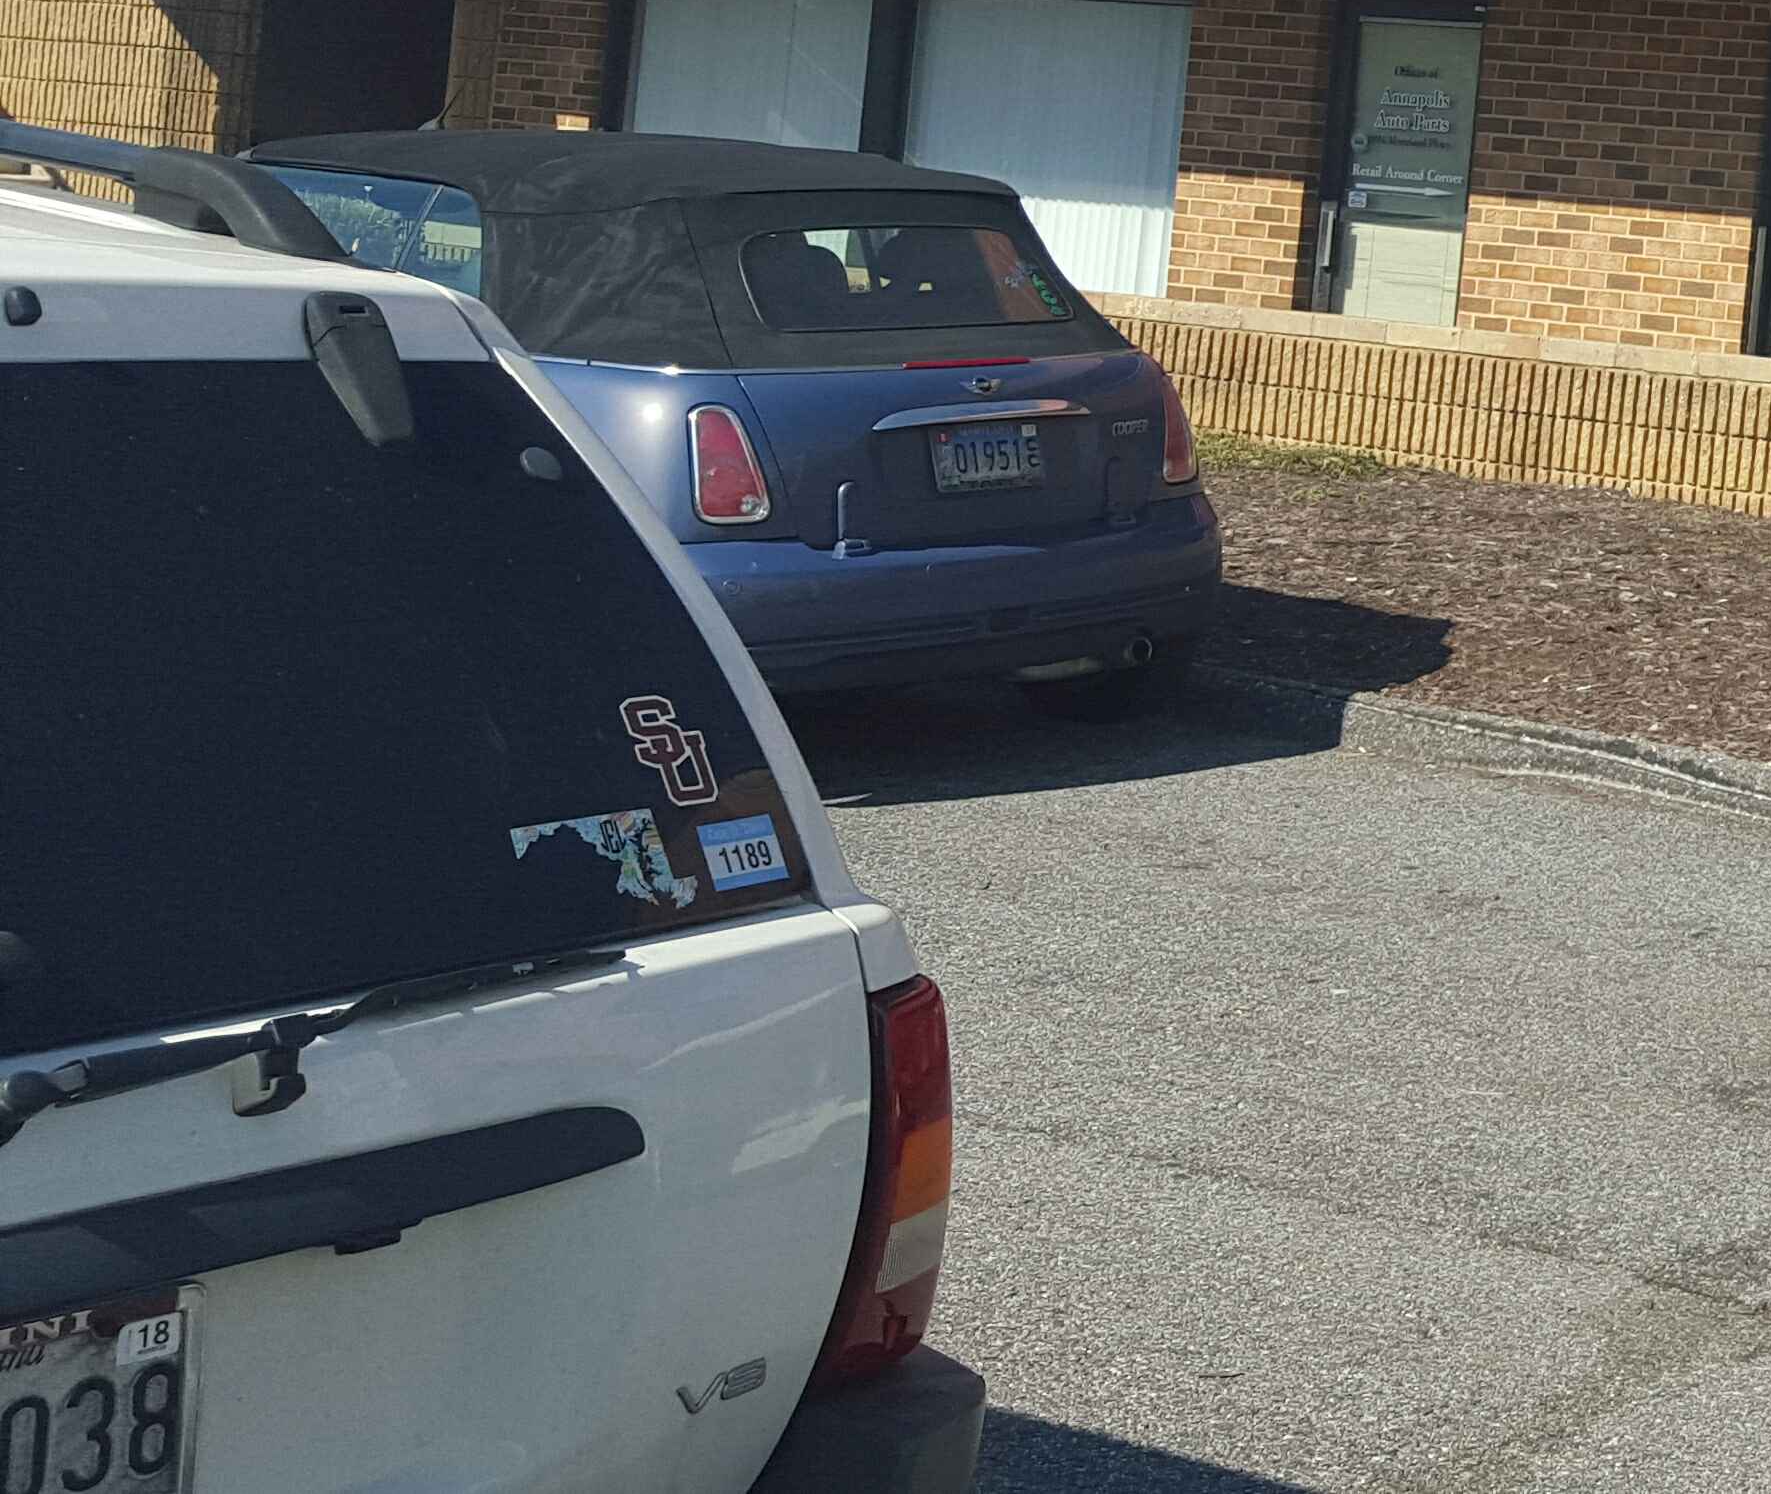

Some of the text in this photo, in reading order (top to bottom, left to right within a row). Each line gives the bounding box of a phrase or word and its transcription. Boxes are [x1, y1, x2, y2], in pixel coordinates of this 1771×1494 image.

[1380, 87, 1450, 111] Annapolis
[1374, 110, 1449, 132] Auto Parts
[1352, 163, 1464, 185] Retail Around Corner
[619, 695, 719, 806] SU
[719, 840, 772, 874] 1189
[138, 1320, 169, 1348] 18
